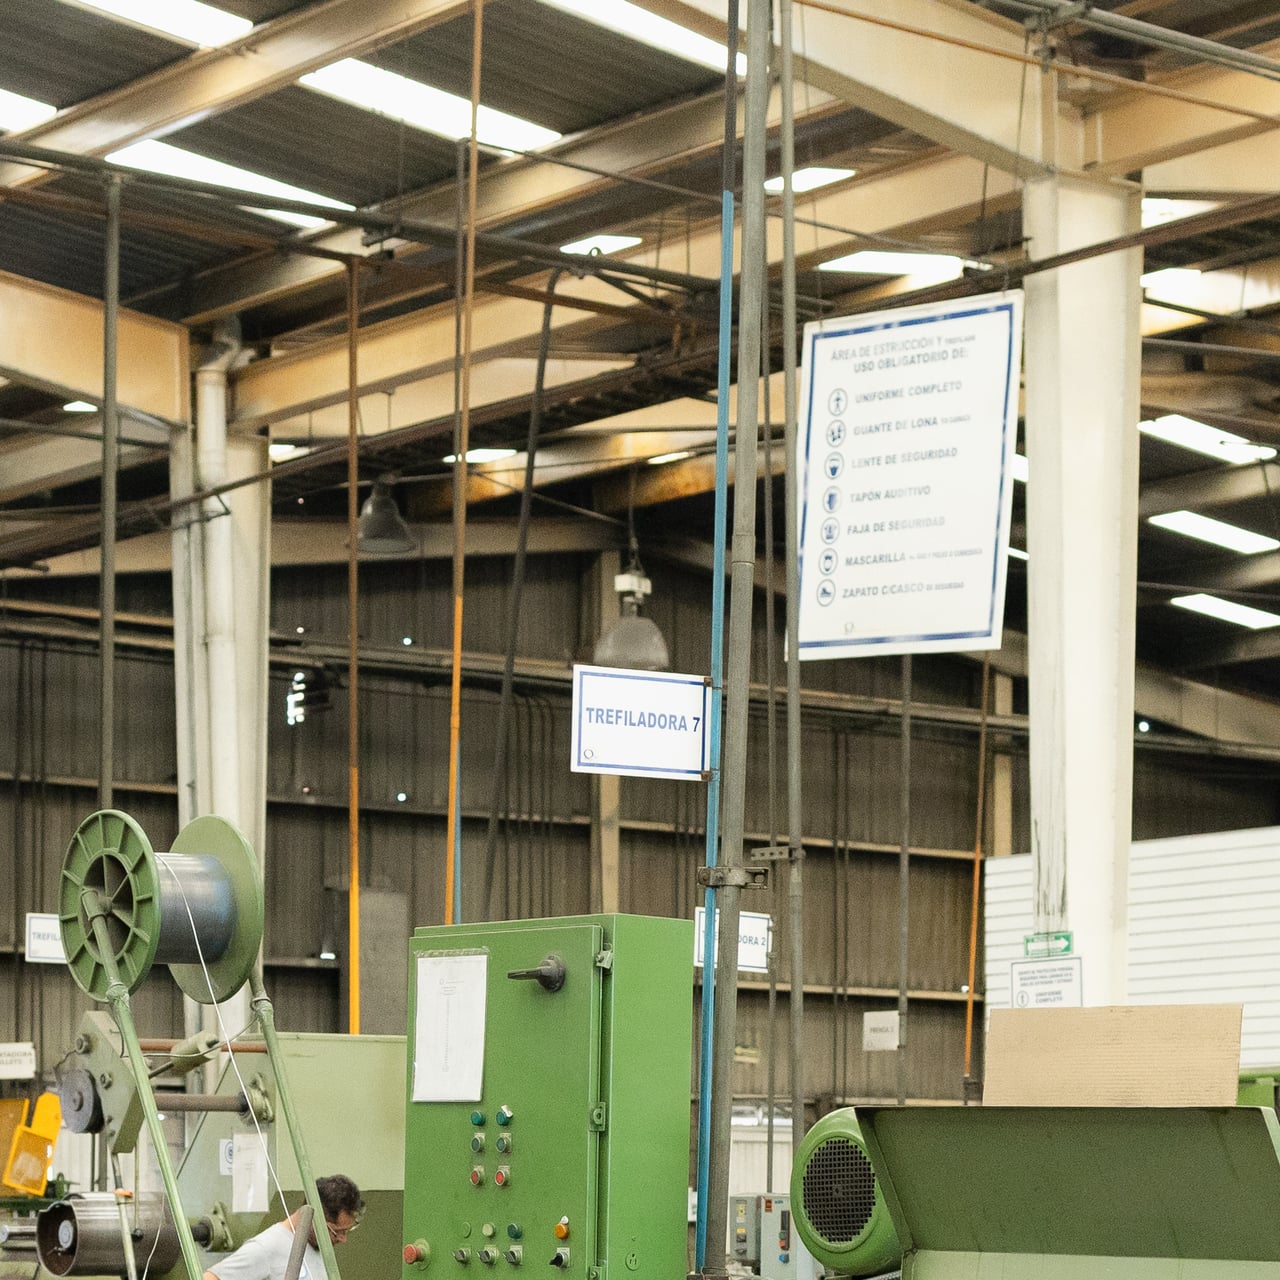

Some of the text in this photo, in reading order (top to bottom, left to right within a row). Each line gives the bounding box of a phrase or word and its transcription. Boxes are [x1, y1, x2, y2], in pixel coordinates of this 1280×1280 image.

[859, 344, 870, 357] DE
[854, 360, 875, 374] USO
[878, 349, 949, 370] OBLIGATORIO
[855, 380, 962, 403] UNIFORME COMPLETO
[853, 421, 892, 436] GUANTE
[895, 420, 908, 431] DE
[911, 417, 938, 429] LONA
[851, 447, 958, 469] LENTE DE SEGURIDAD
[884, 485, 931, 500] AUDITIVO
[847, 516, 945, 535] FAJA DE SEGURIDAD
[845, 552, 906, 566] MASCARILLA
[842, 586, 879, 599] ZAPATO
[585, 706, 701, 732] TREFILADORA 7
[761, 936, 767, 946] 2
